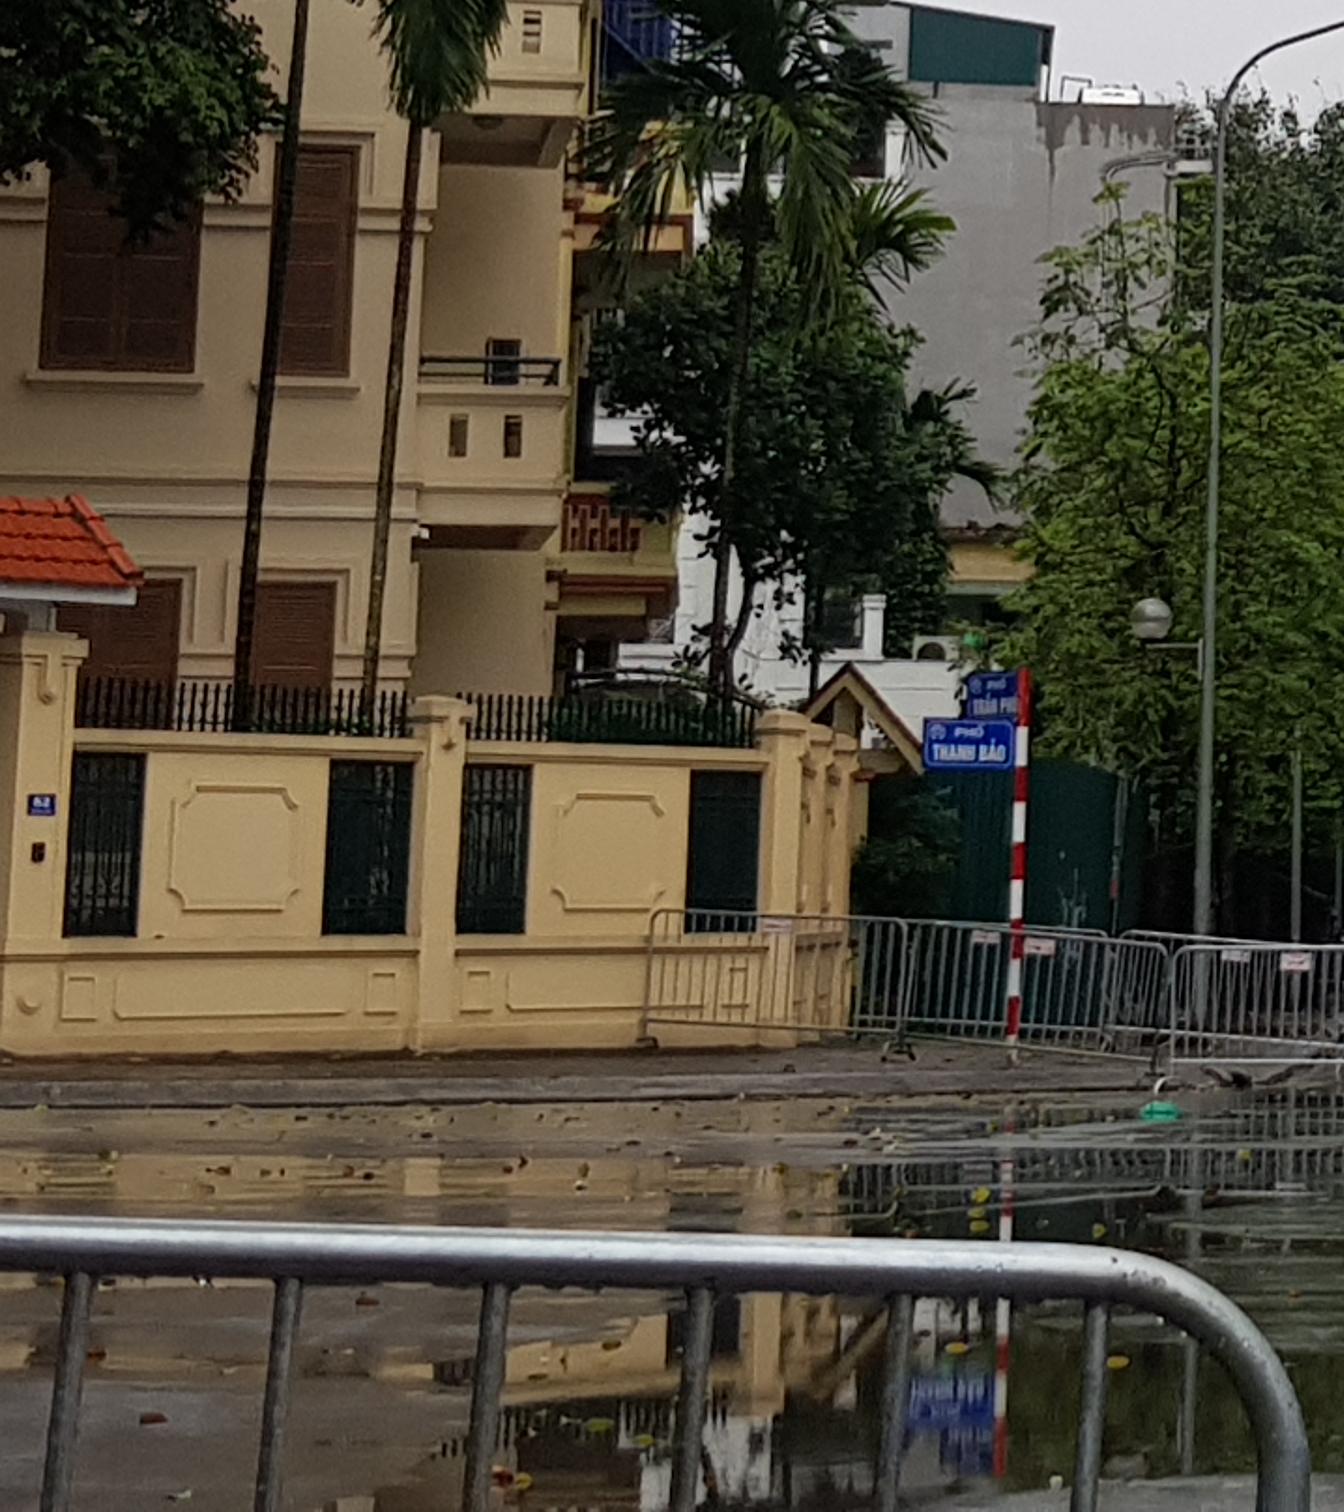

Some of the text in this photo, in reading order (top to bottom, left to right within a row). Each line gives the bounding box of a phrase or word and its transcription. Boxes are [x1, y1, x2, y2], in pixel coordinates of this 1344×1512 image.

[954, 722, 985, 738] PHỐ
[931, 737, 1007, 763] THANH BẢO
